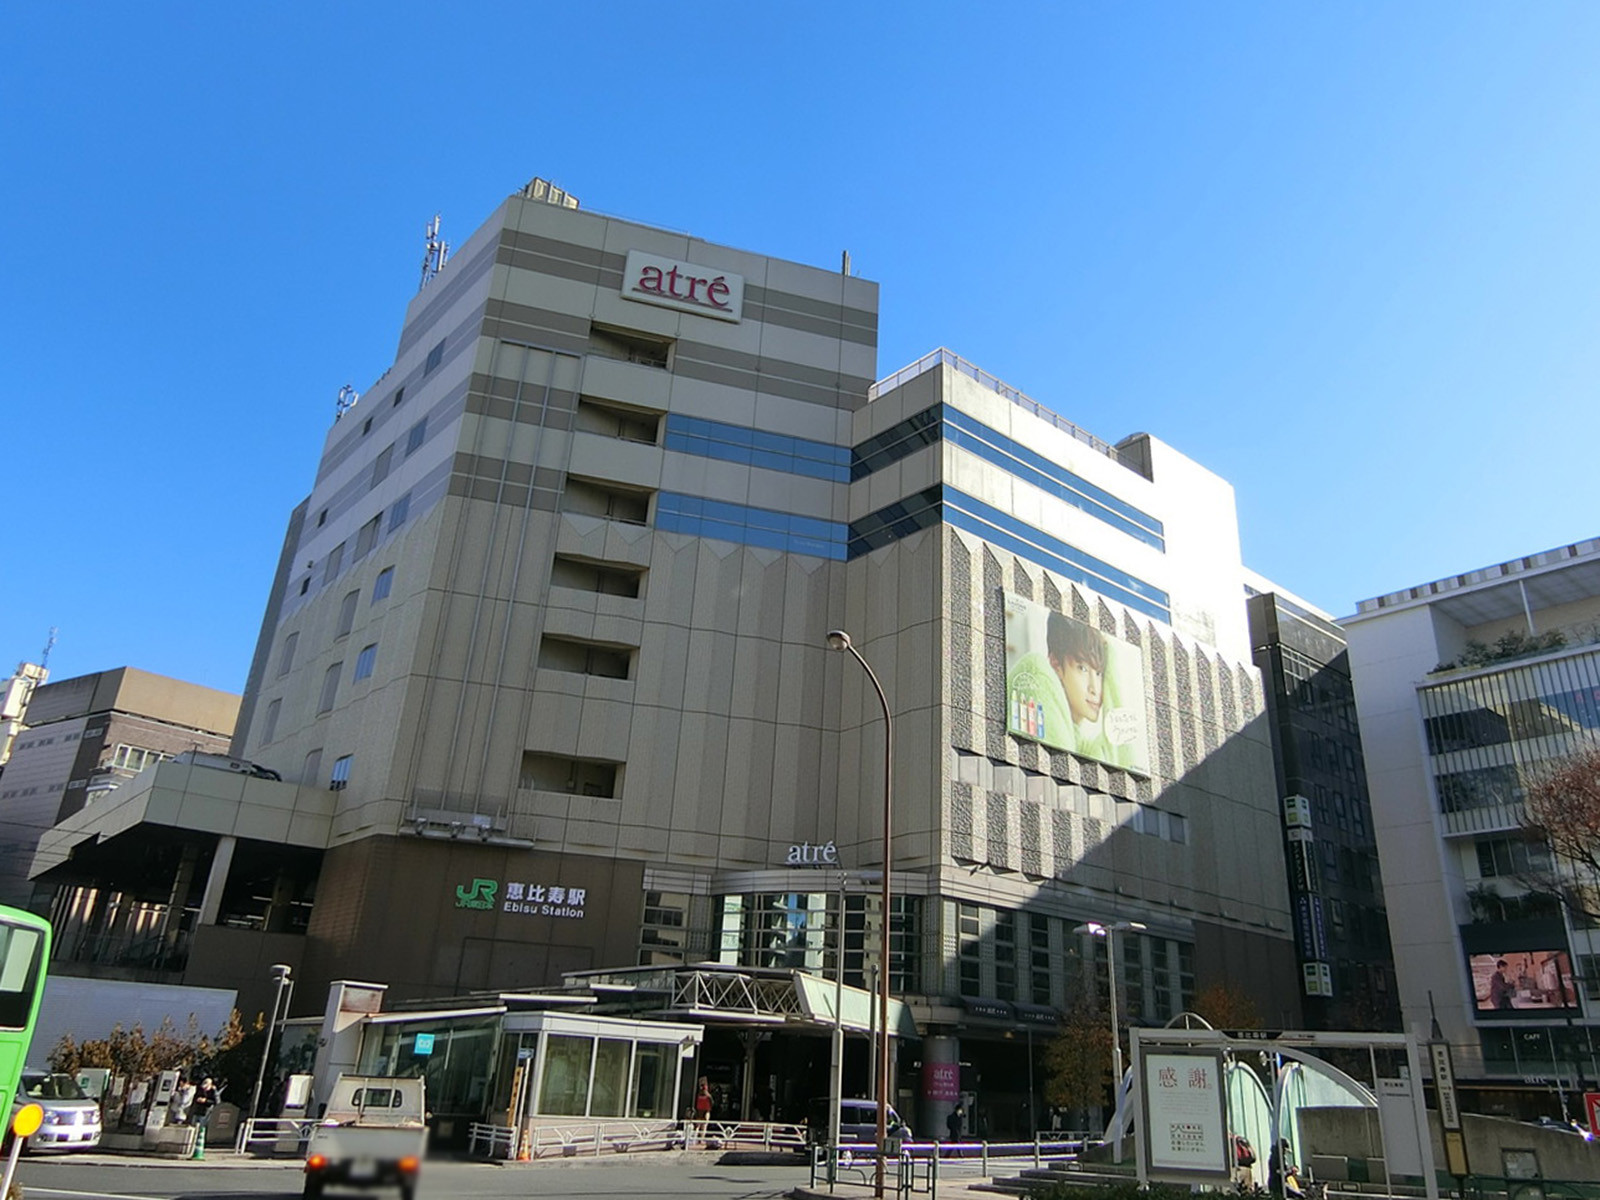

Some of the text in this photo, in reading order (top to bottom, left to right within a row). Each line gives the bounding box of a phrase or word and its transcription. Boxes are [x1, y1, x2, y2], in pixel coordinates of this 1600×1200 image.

[638, 264, 730, 308] atré
[787, 840, 837, 863] atré
[456, 878, 498, 903] JR
[506, 882, 586, 906] 恵比寿駅
[503, 901, 584, 918] Ebisu Station
